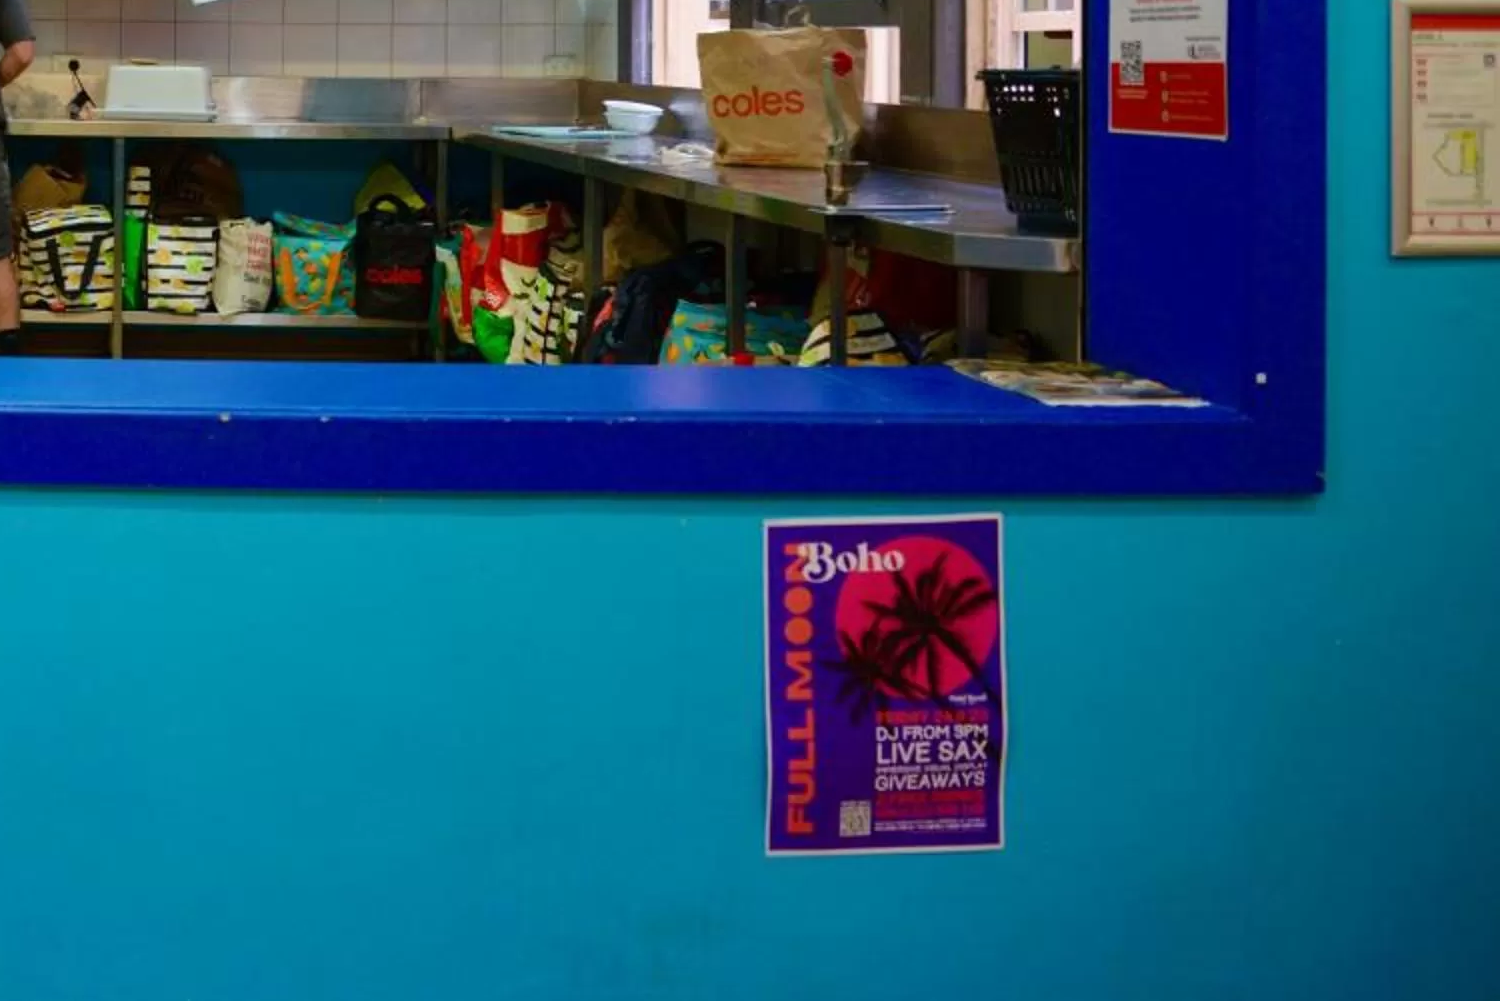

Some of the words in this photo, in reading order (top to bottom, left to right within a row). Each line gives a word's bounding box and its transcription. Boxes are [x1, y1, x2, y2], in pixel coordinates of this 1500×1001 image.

[712, 85, 805, 118] coles
[797, 542, 905, 583] Boho
[875, 726, 899, 742] DJ
[902, 724, 950, 740] FROM
[876, 741, 931, 765] LIVE
[938, 740, 988, 762] SAX
[787, 708, 815, 833] FULL
[875, 771, 985, 791] GIVEAWAYS
